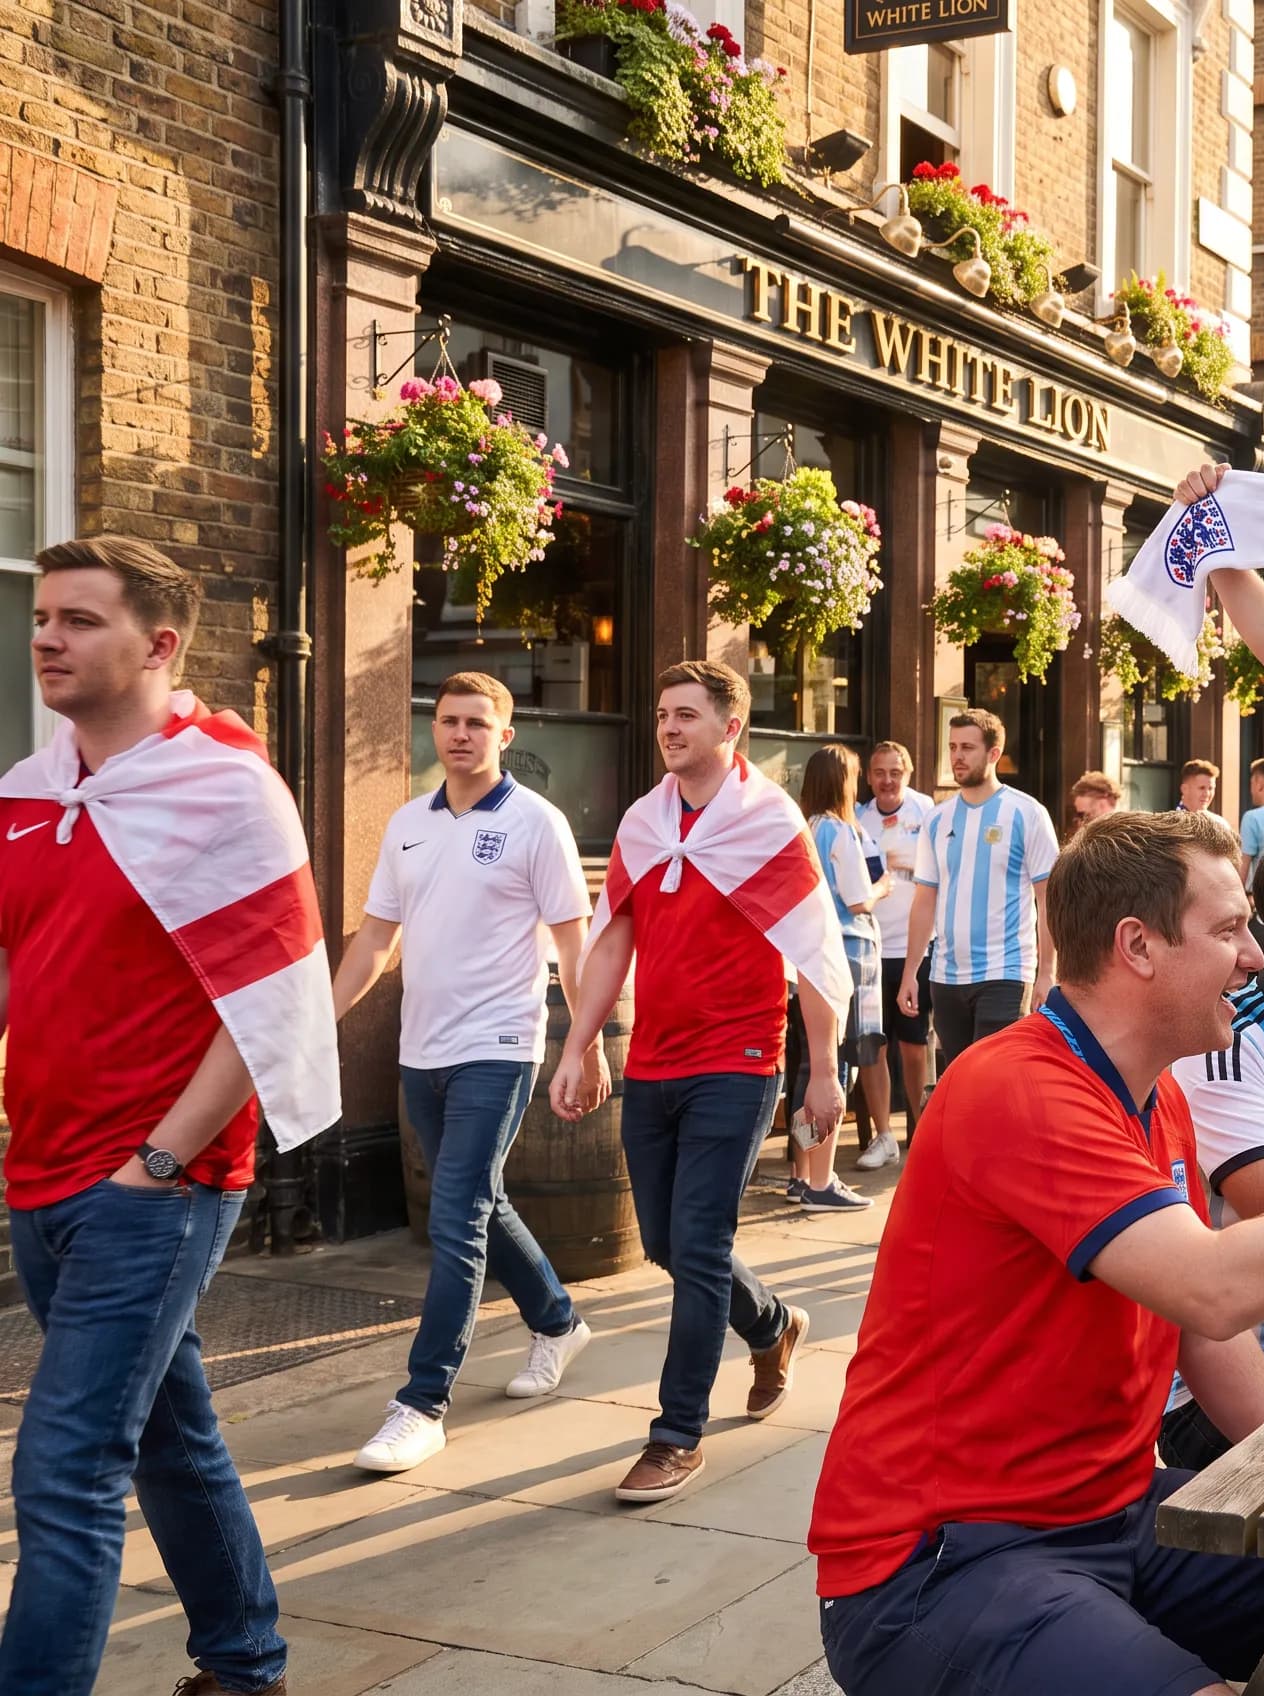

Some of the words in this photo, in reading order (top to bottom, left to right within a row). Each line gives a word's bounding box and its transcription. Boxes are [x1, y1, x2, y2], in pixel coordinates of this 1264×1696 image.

[866, 3, 931, 28] WHITE
[939, 0, 988, 17] LION
[736, 254, 857, 354] THE
[872, 309, 1016, 414] WHITE
[1027, 376, 1112, 452] LION
